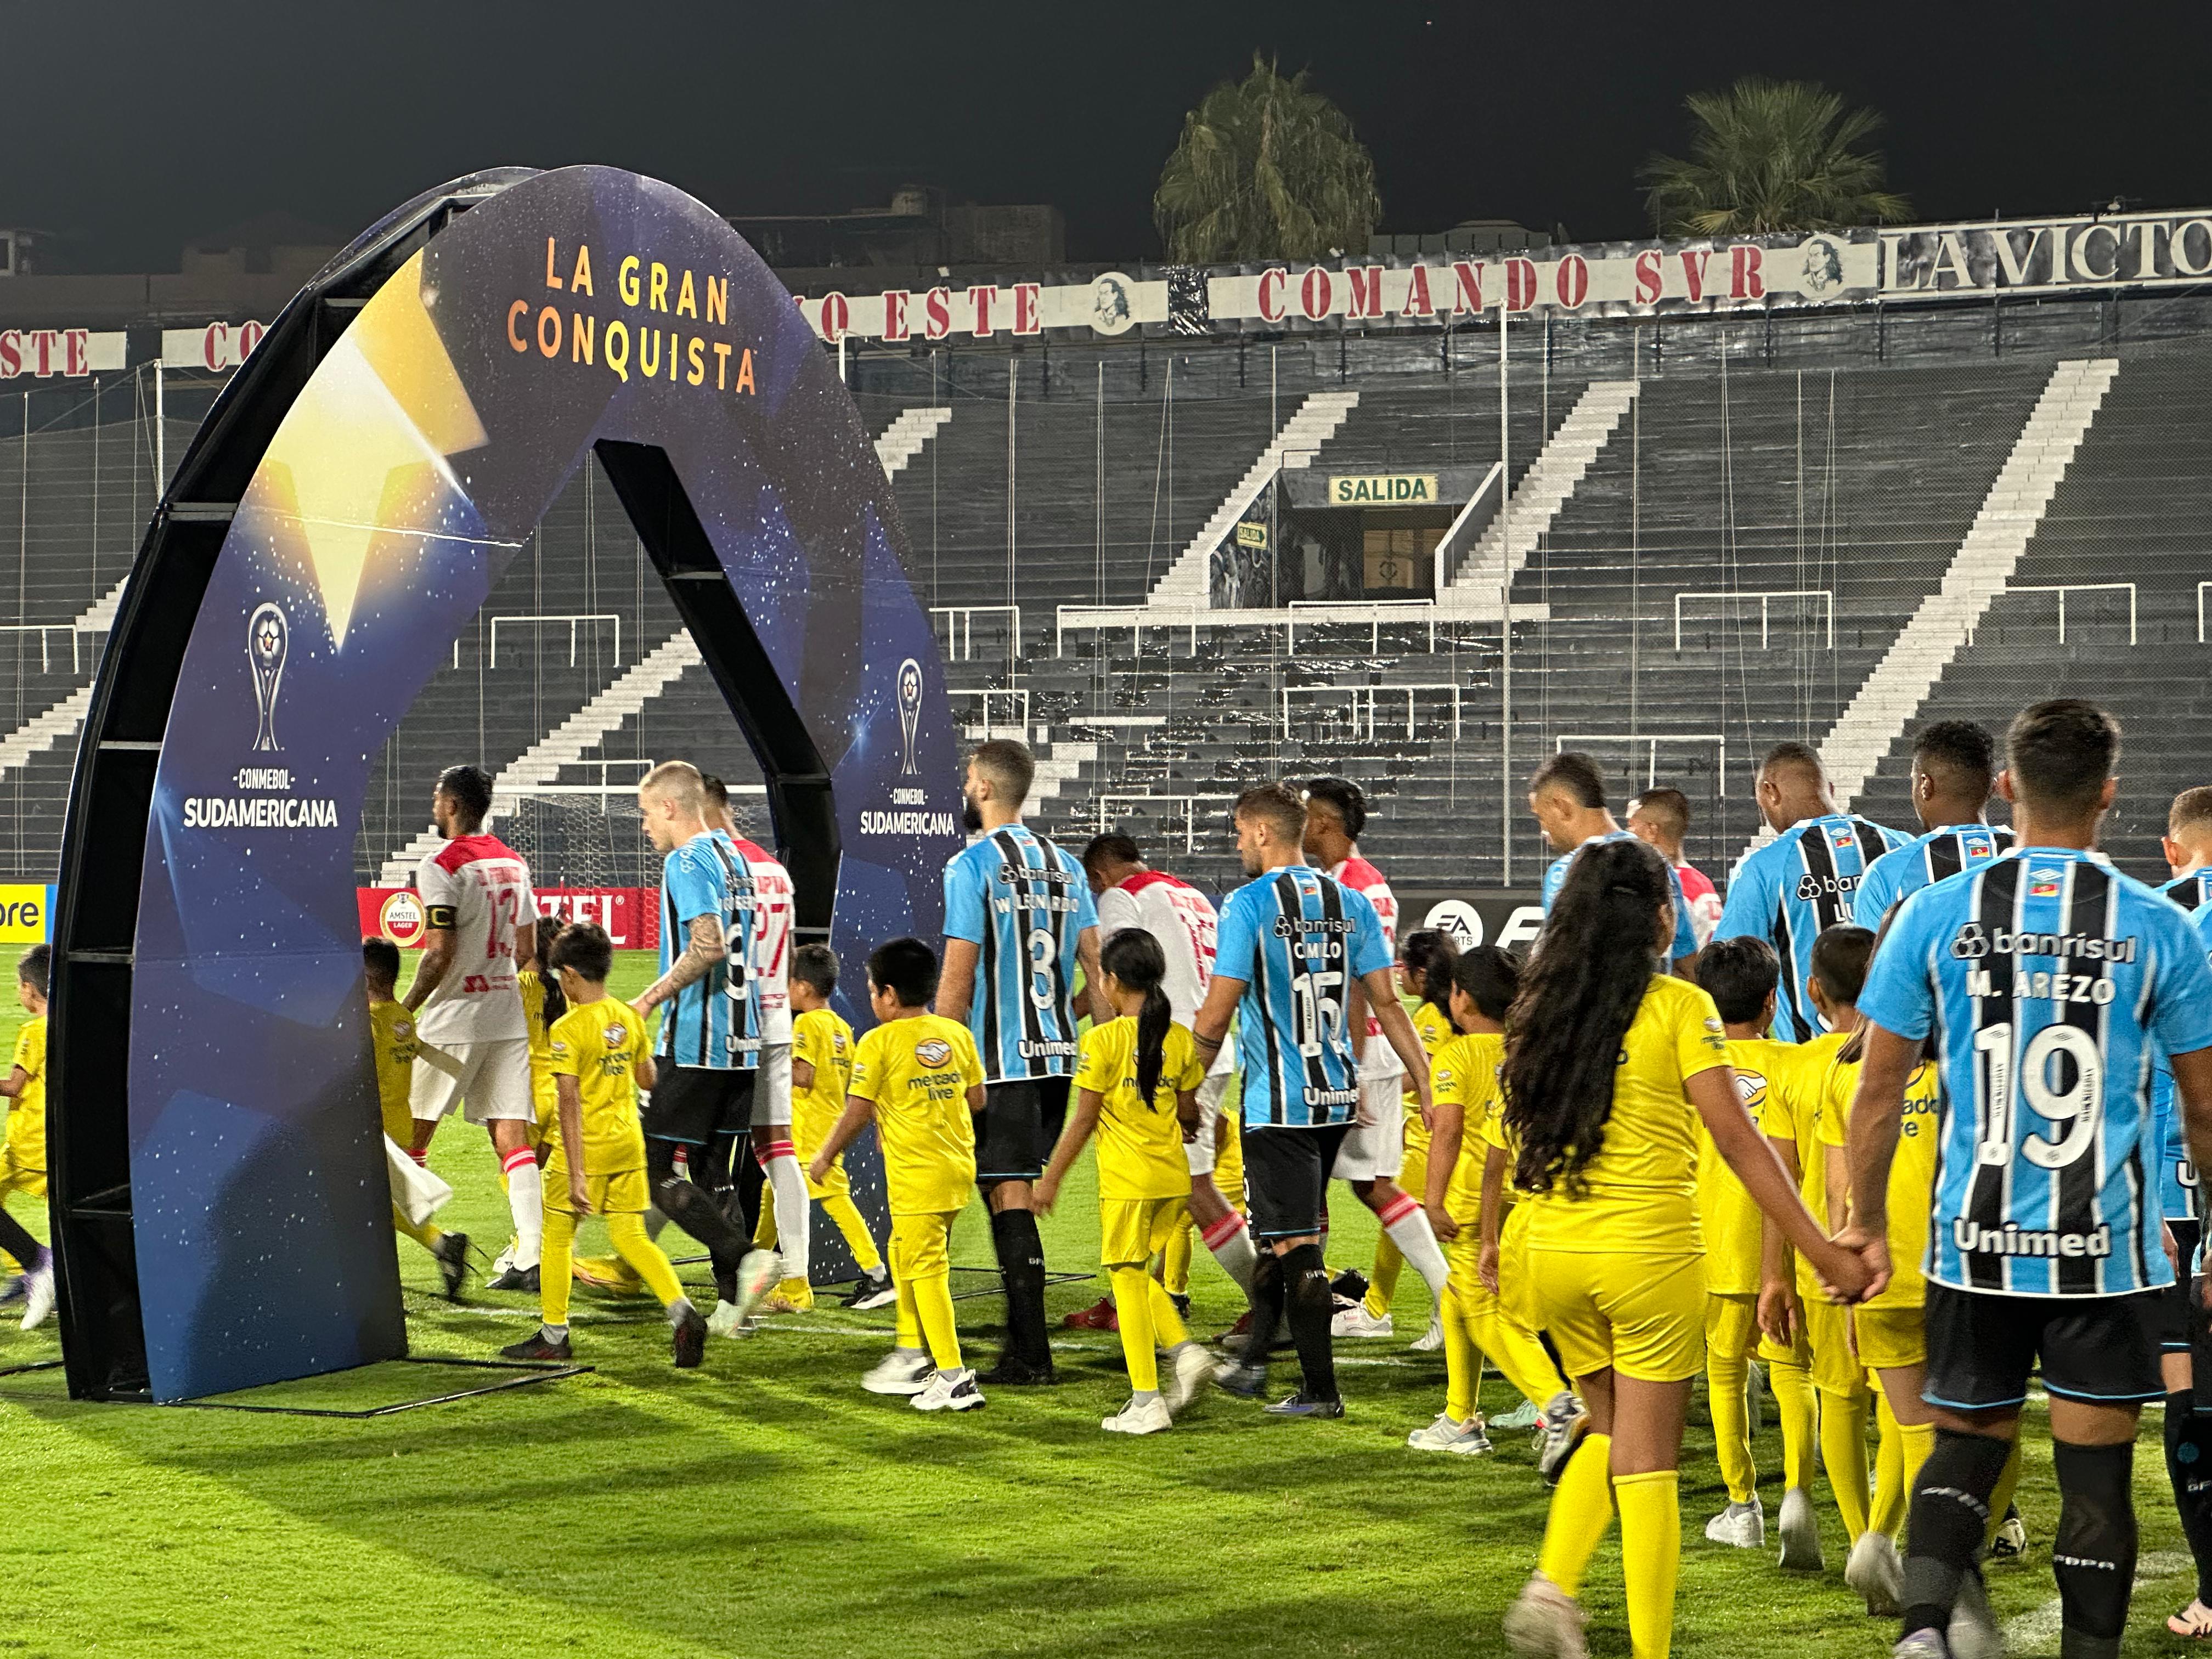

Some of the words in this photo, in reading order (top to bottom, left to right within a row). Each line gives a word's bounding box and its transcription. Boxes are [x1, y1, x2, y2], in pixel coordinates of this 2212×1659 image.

[546, 236, 594, 297] LA
[619, 255, 727, 325] GRAN
[1879, 232, 1978, 291] LA
[1257, 252, 1589, 321] COMANDO
[1634, 244, 1767, 304] SVR
[883, 283, 1041, 341] ESTE
[507, 299, 756, 395] CONQUISTA
[1338, 477, 1428, 503] SALIDA
[183, 798, 338, 828] SUDAMERICANA
[860, 811, 955, 836] SUDAMERICANA
[389, 911, 417, 920] AMSTEL
[431, 907, 450, 926] C
[1993, 927, 2137, 964] banrisul
[1027, 928, 1057, 1010] 3
[2012, 970, 2117, 1006] AREZO
[1975, 1022, 2103, 1169] 19
[1953, 1218, 2111, 1257] Unimed
